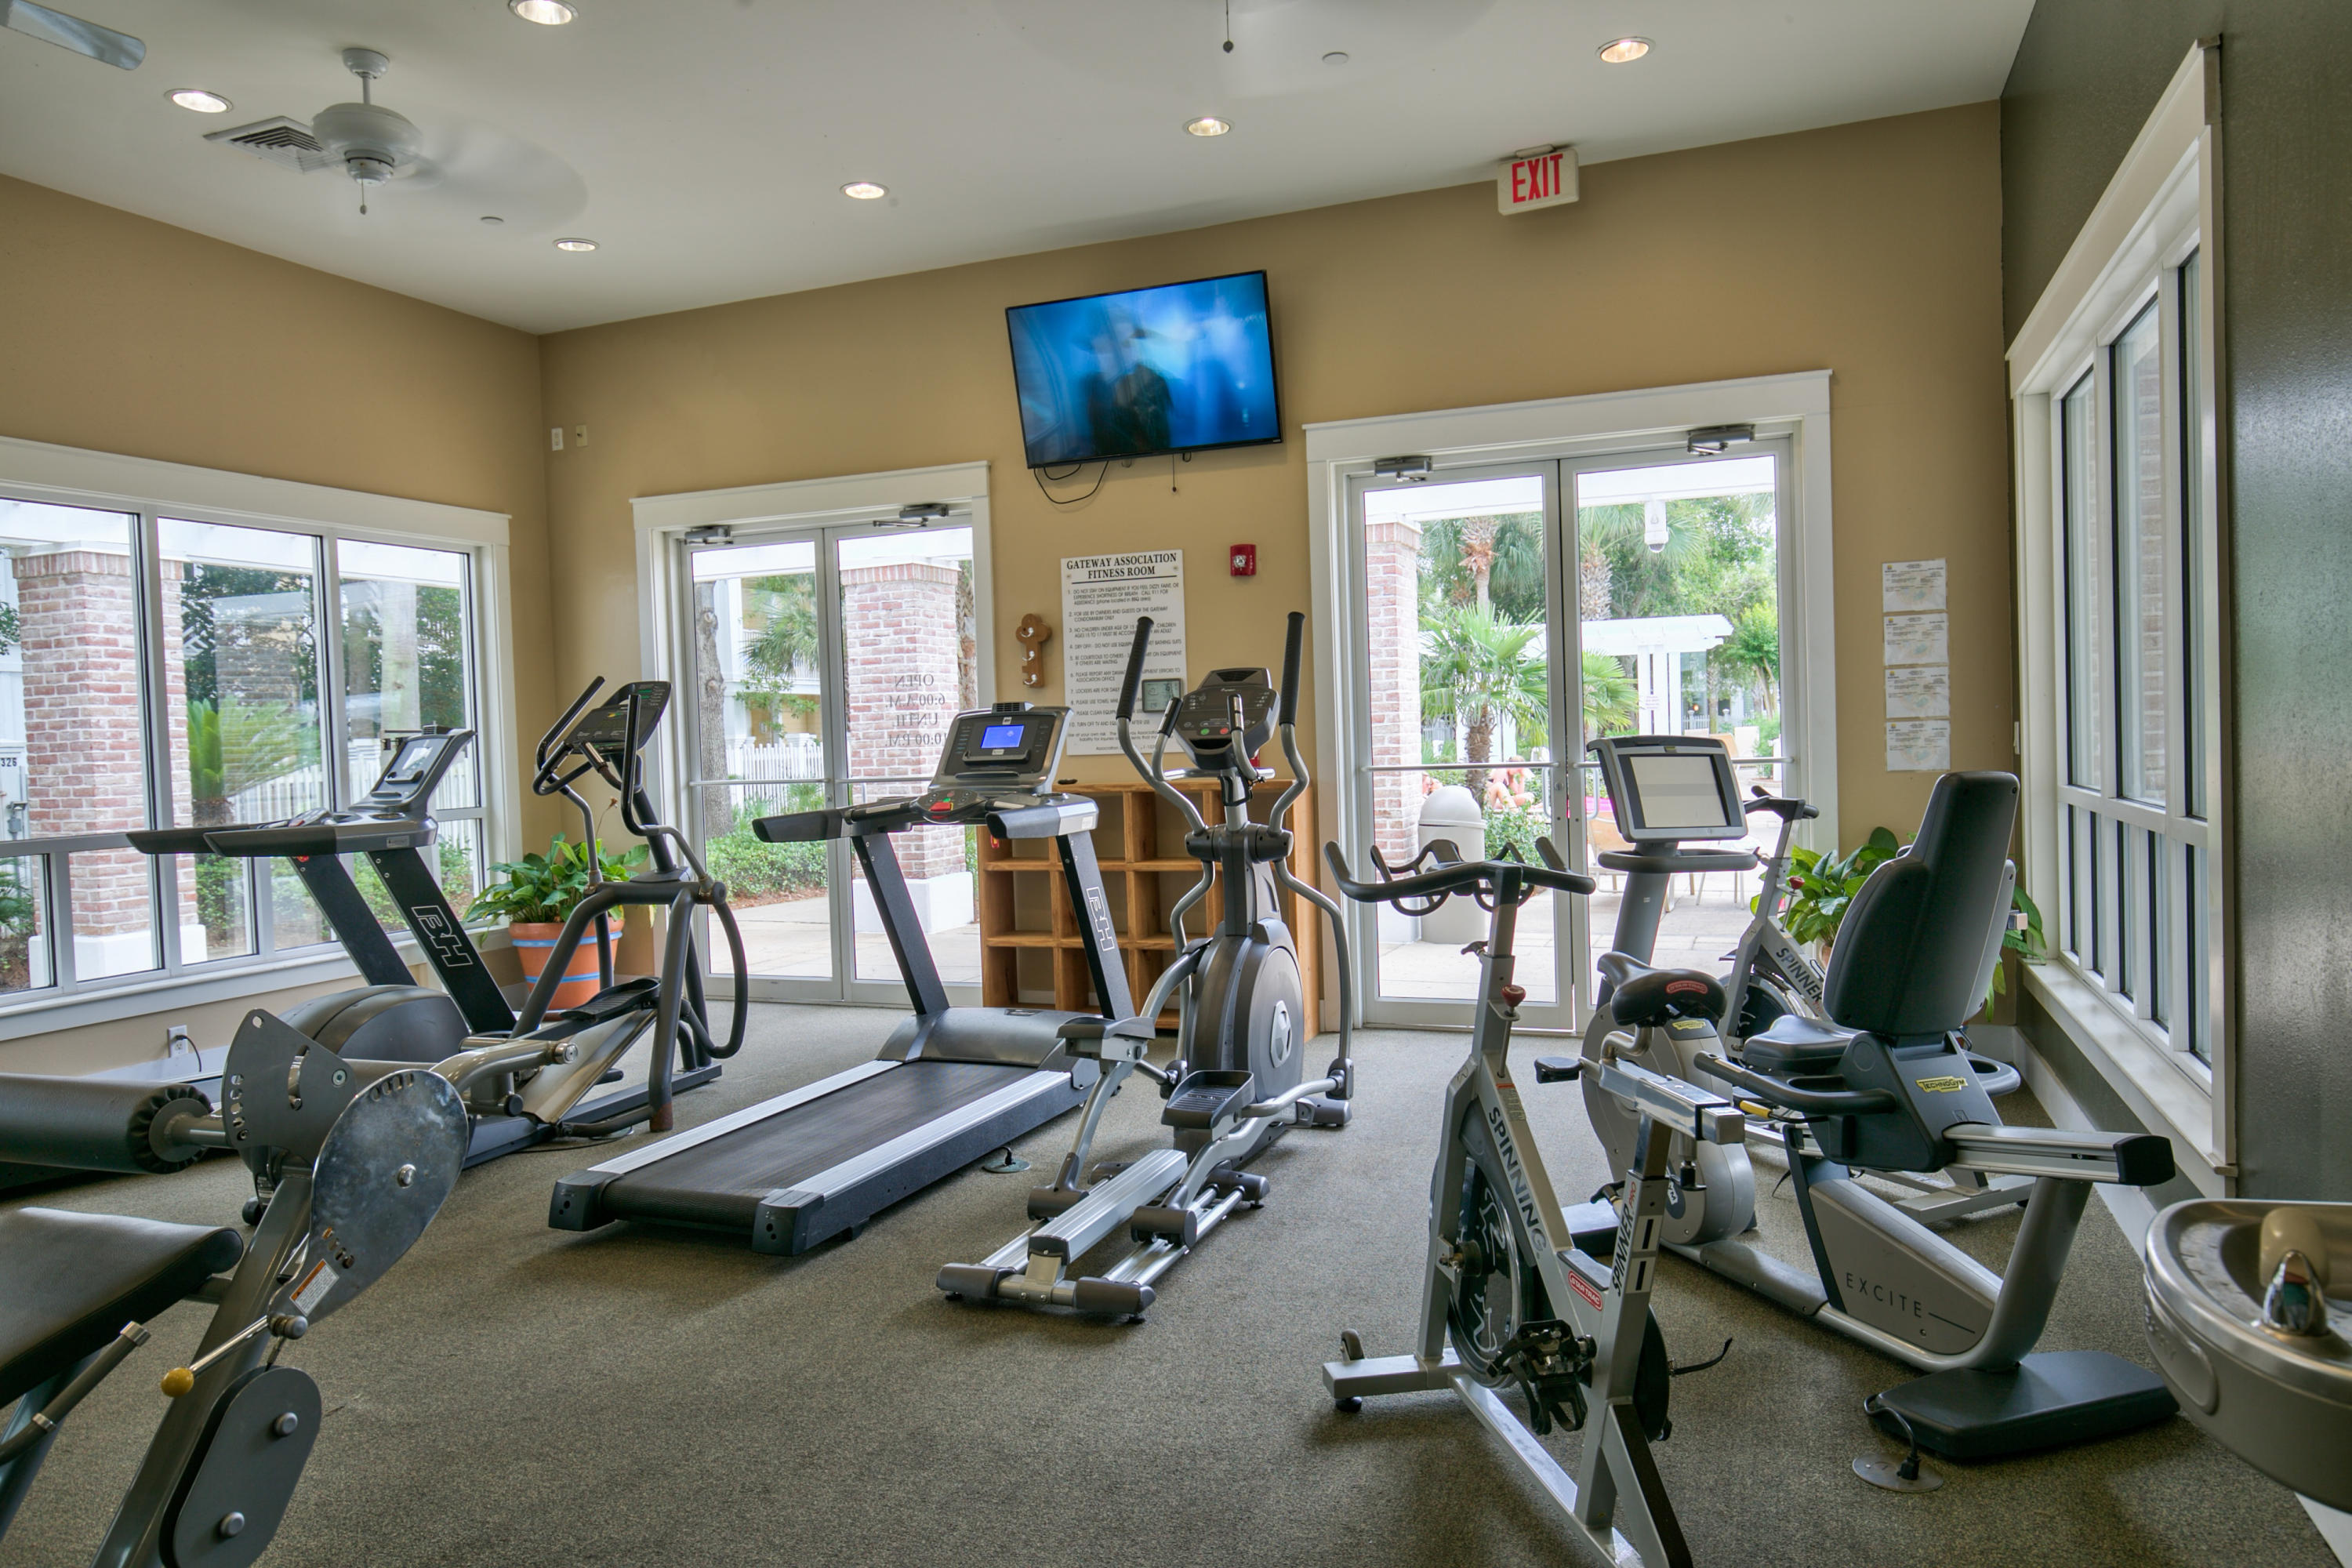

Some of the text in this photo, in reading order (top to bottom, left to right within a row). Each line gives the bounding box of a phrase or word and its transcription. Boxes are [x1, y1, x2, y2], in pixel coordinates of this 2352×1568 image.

[1512, 153, 1563, 203] EXIT
[1066, 552, 1177, 570] GATEWAY ASSOCIATION
[1088, 565, 1156, 579] FITNESS ROOM
[411, 905, 474, 967] BH
[1086, 886, 1116, 952] BH
[1489, 1105, 1548, 1253] SPINNING
[1612, 1203, 1634, 1298] SPINNER
[1571, 1276, 1601, 1305] STAR TRAC
[1846, 1272, 1922, 1318] EXCITE
